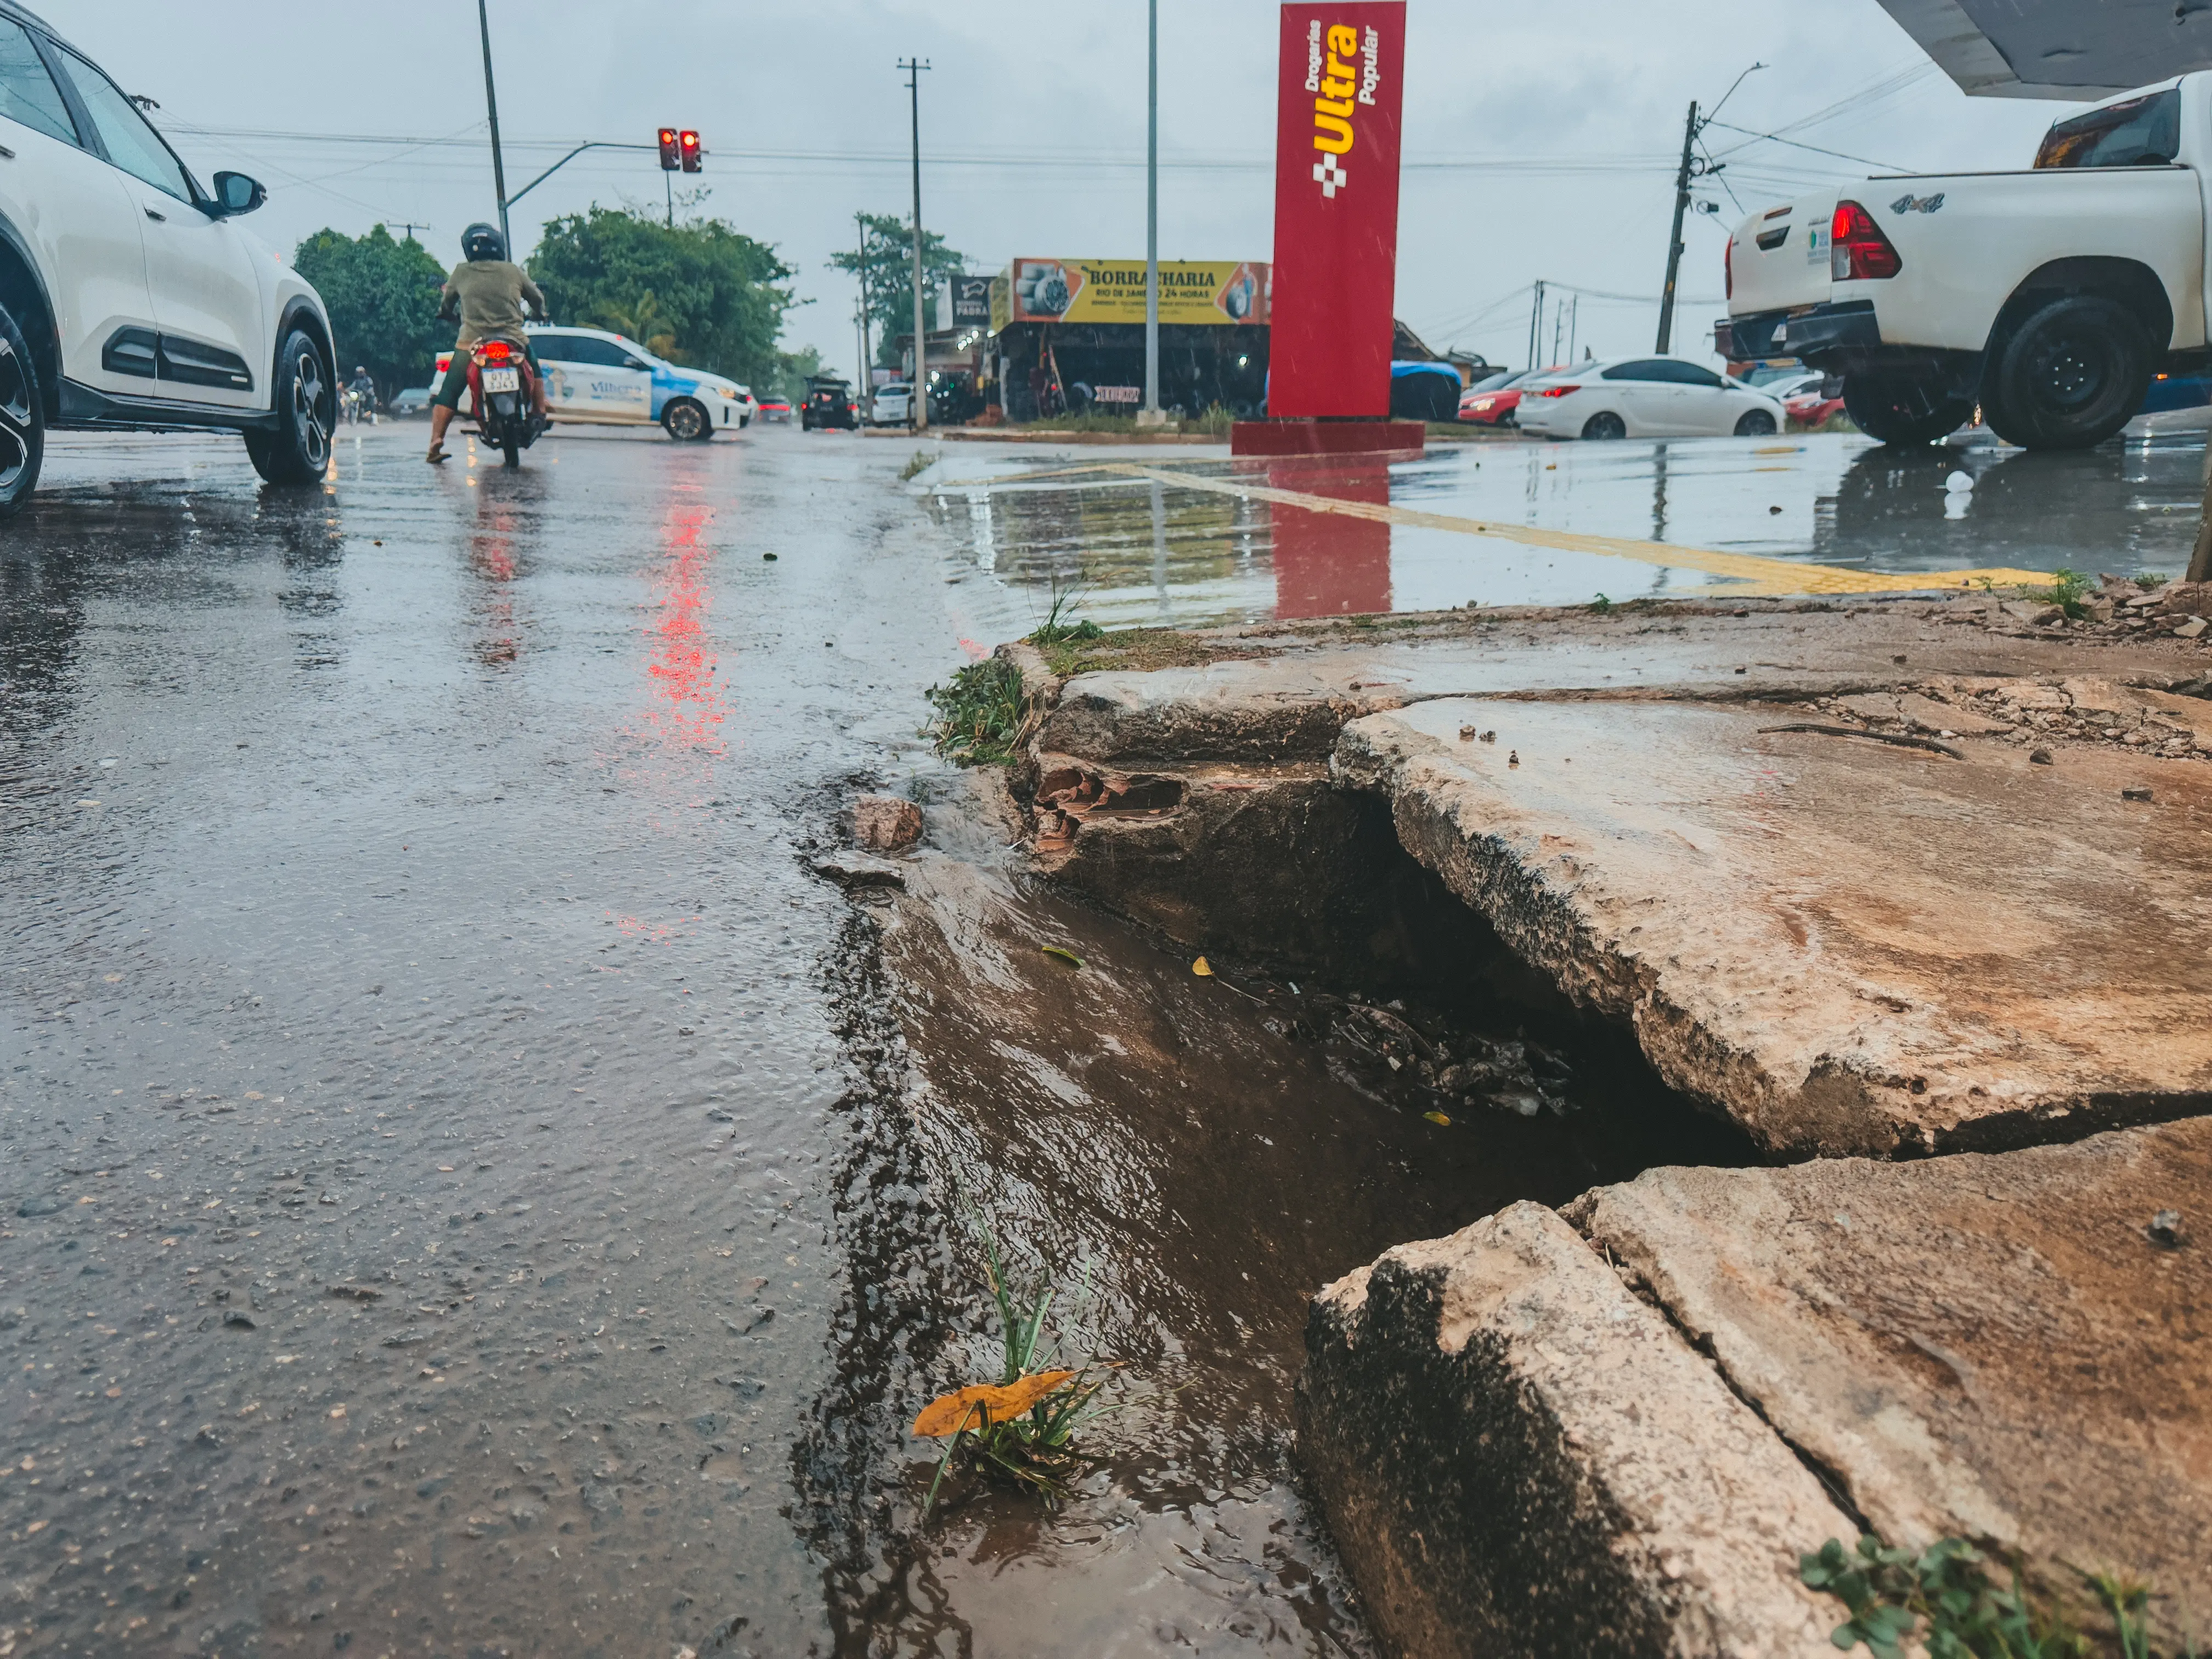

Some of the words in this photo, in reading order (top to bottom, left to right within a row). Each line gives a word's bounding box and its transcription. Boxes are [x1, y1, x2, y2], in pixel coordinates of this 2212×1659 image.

[1313, 24, 1357, 155] Ultra
[1358, 25, 1381, 105] Popular
[1126, 289, 1163, 298] JANEO
